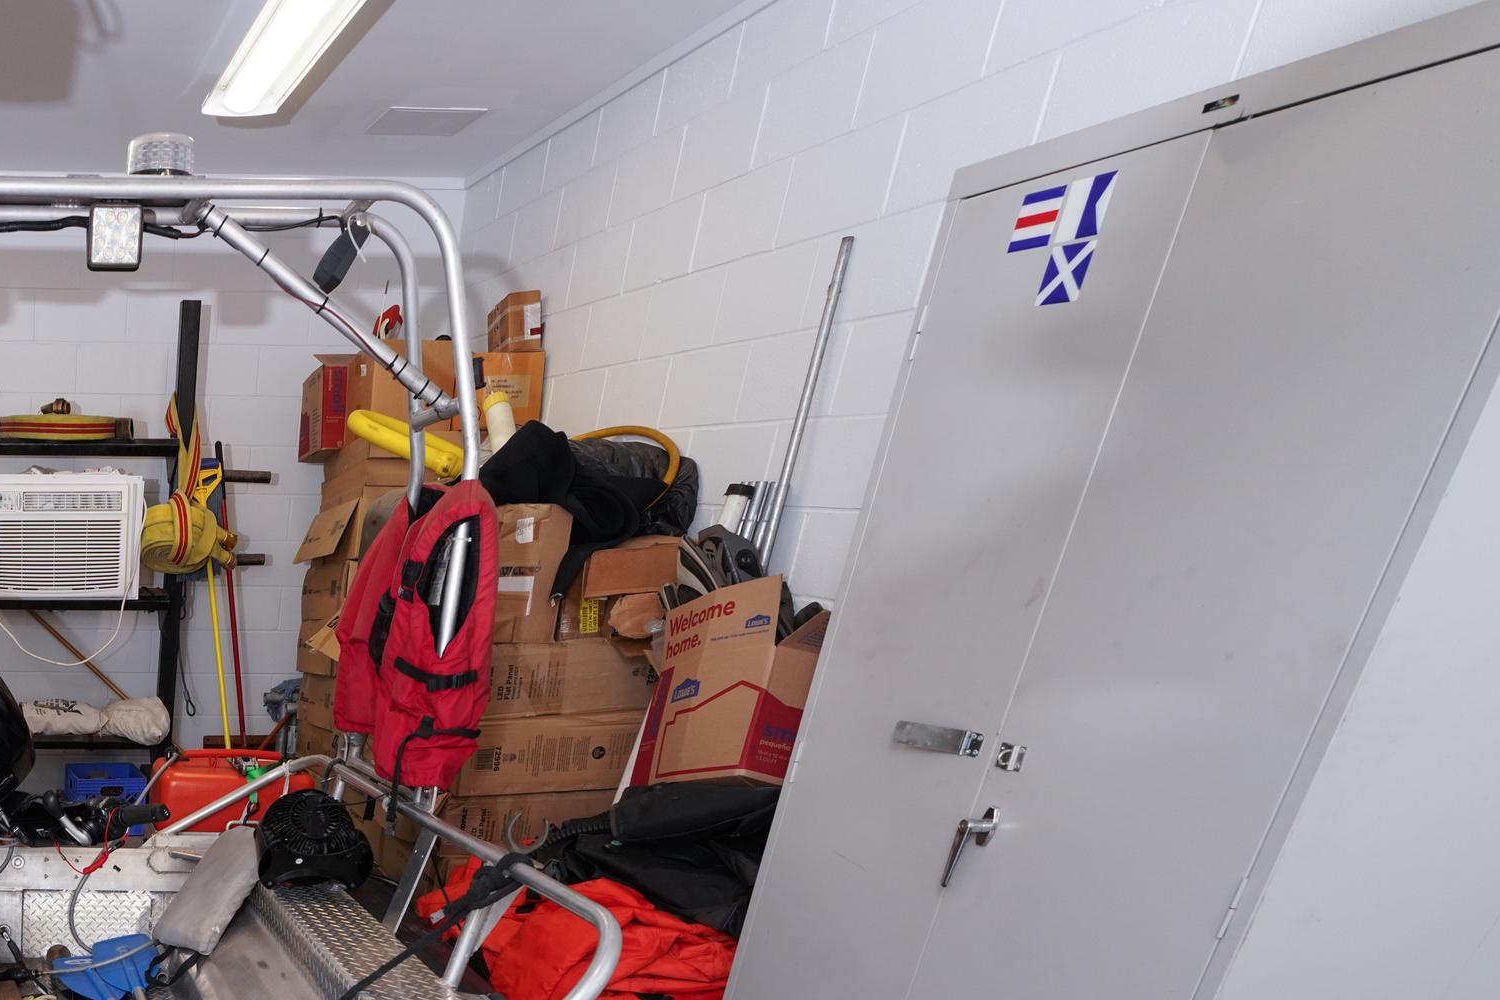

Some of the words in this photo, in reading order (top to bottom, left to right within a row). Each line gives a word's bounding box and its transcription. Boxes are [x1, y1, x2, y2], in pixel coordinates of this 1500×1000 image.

[669, 600, 736, 637] Welcome
[665, 634, 701, 660] home.
[506, 664, 514, 685] Panel
[673, 685, 696, 701] LOWE'S
